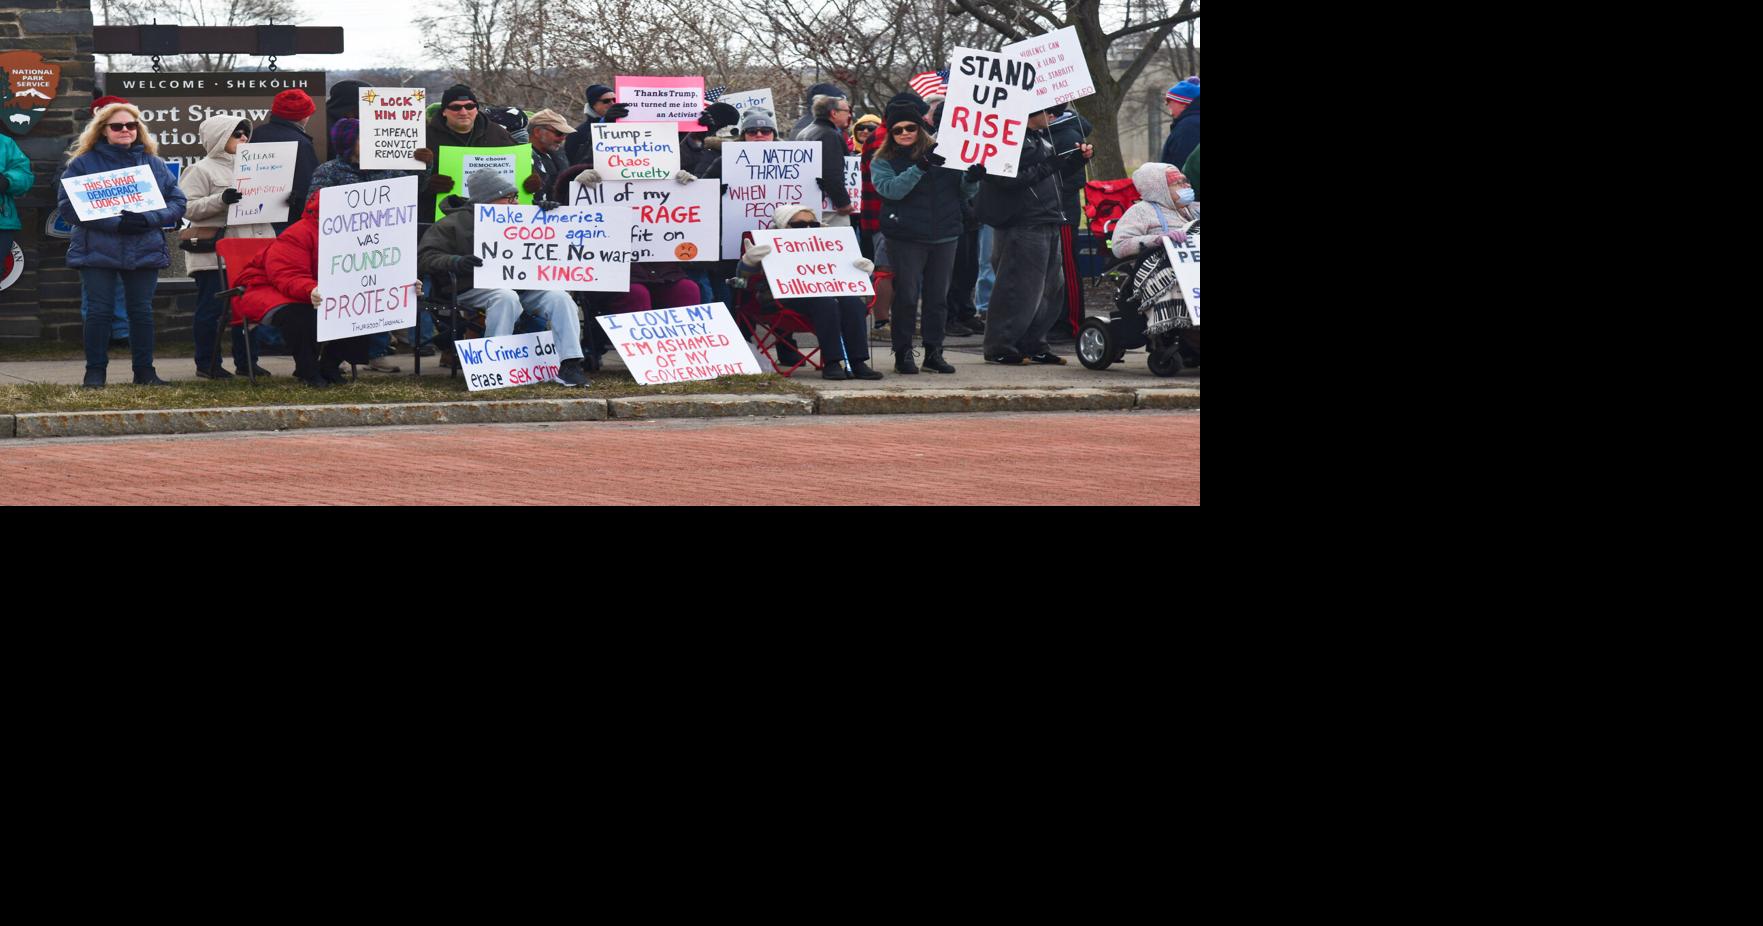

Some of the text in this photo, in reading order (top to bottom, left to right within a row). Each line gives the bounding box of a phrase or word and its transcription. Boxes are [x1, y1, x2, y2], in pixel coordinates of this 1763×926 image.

[960, 55, 1037, 91] STAND
[123, 80, 205, 89] WELCOME
[634, 89, 668, 97] Thanks
[1036, 79, 1069, 97] AND PEACE
[1077, 85, 1094, 98] LEO
[380, 96, 413, 107] LOCK
[973, 84, 1008, 108] UP
[138, 105, 181, 122] ort
[374, 110, 422, 121] HIM UP!
[374, 127, 418, 138] IMPEACH
[593, 125, 640, 144] Trump
[951, 106, 1021, 146] RISE
[375, 140, 418, 149] CONVICT
[595, 141, 673, 157] Corruption
[608, 154, 650, 168] Chaos
[735, 148, 813, 165] A NATION
[960, 140, 998, 168] UP
[621, 167, 670, 180] Cruelty
[745, 163, 800, 180] THRIVES
[83, 175, 136, 191] THIS IS WHAT
[86, 184, 139, 200] DEMOCRACY
[90, 192, 145, 209] LOOKS LIKE
[575, 182, 670, 206] All of my
[728, 184, 803, 201] WHEN ITS
[322, 204, 416, 236] GOVERNMENT
[479, 206, 605, 225] Make America
[632, 205, 702, 224] RAGE
[357, 233, 380, 247] WAS
[503, 226, 555, 240] GOOD
[630, 224, 685, 243] fit on
[481, 241, 514, 259] No
[567, 244, 595, 261] No
[773, 235, 844, 254] Families
[331, 246, 401, 275] FOUNDED
[796, 262, 837, 276] over
[360, 274, 377, 287] ON
[502, 265, 598, 282] No KINGS.
[776, 278, 867, 295] billionaires
[325, 284, 417, 320] PROTEST
[604, 305, 713, 330] I LOVE MY
[458, 342, 484, 365] War
[484, 339, 529, 362] Crimes
[621, 334, 730, 357] I'M ASHAMED
[656, 350, 711, 368] OF MY
[470, 372, 504, 388] erase
[644, 362, 745, 383] GOVERNMENT
